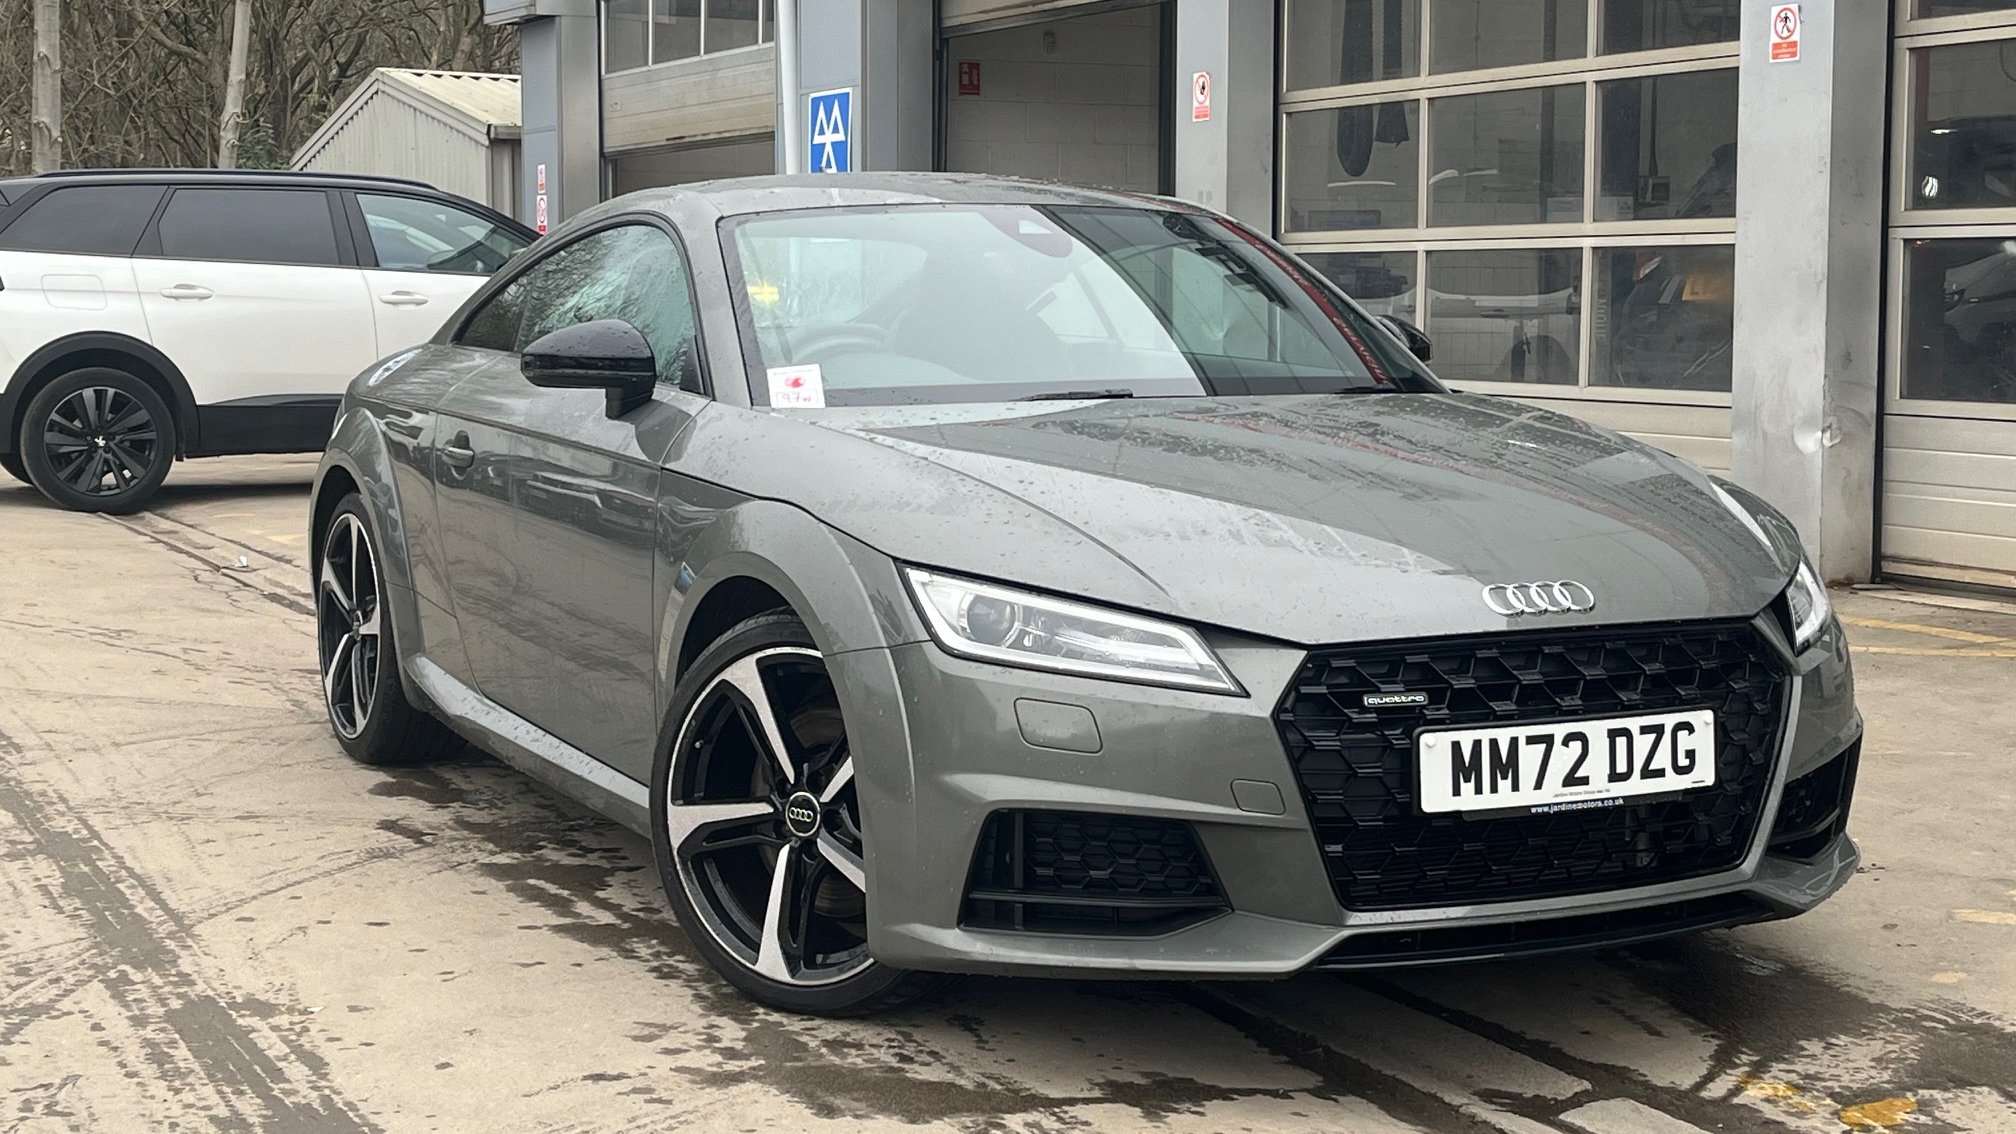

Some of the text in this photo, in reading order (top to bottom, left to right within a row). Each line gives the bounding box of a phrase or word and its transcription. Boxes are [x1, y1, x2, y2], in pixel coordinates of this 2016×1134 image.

[1367, 695, 1425, 705] quattro
[1450, 721, 1696, 797] MM72 DZG
[1530, 797, 1624, 814] www.jardinemotors.co.uk
